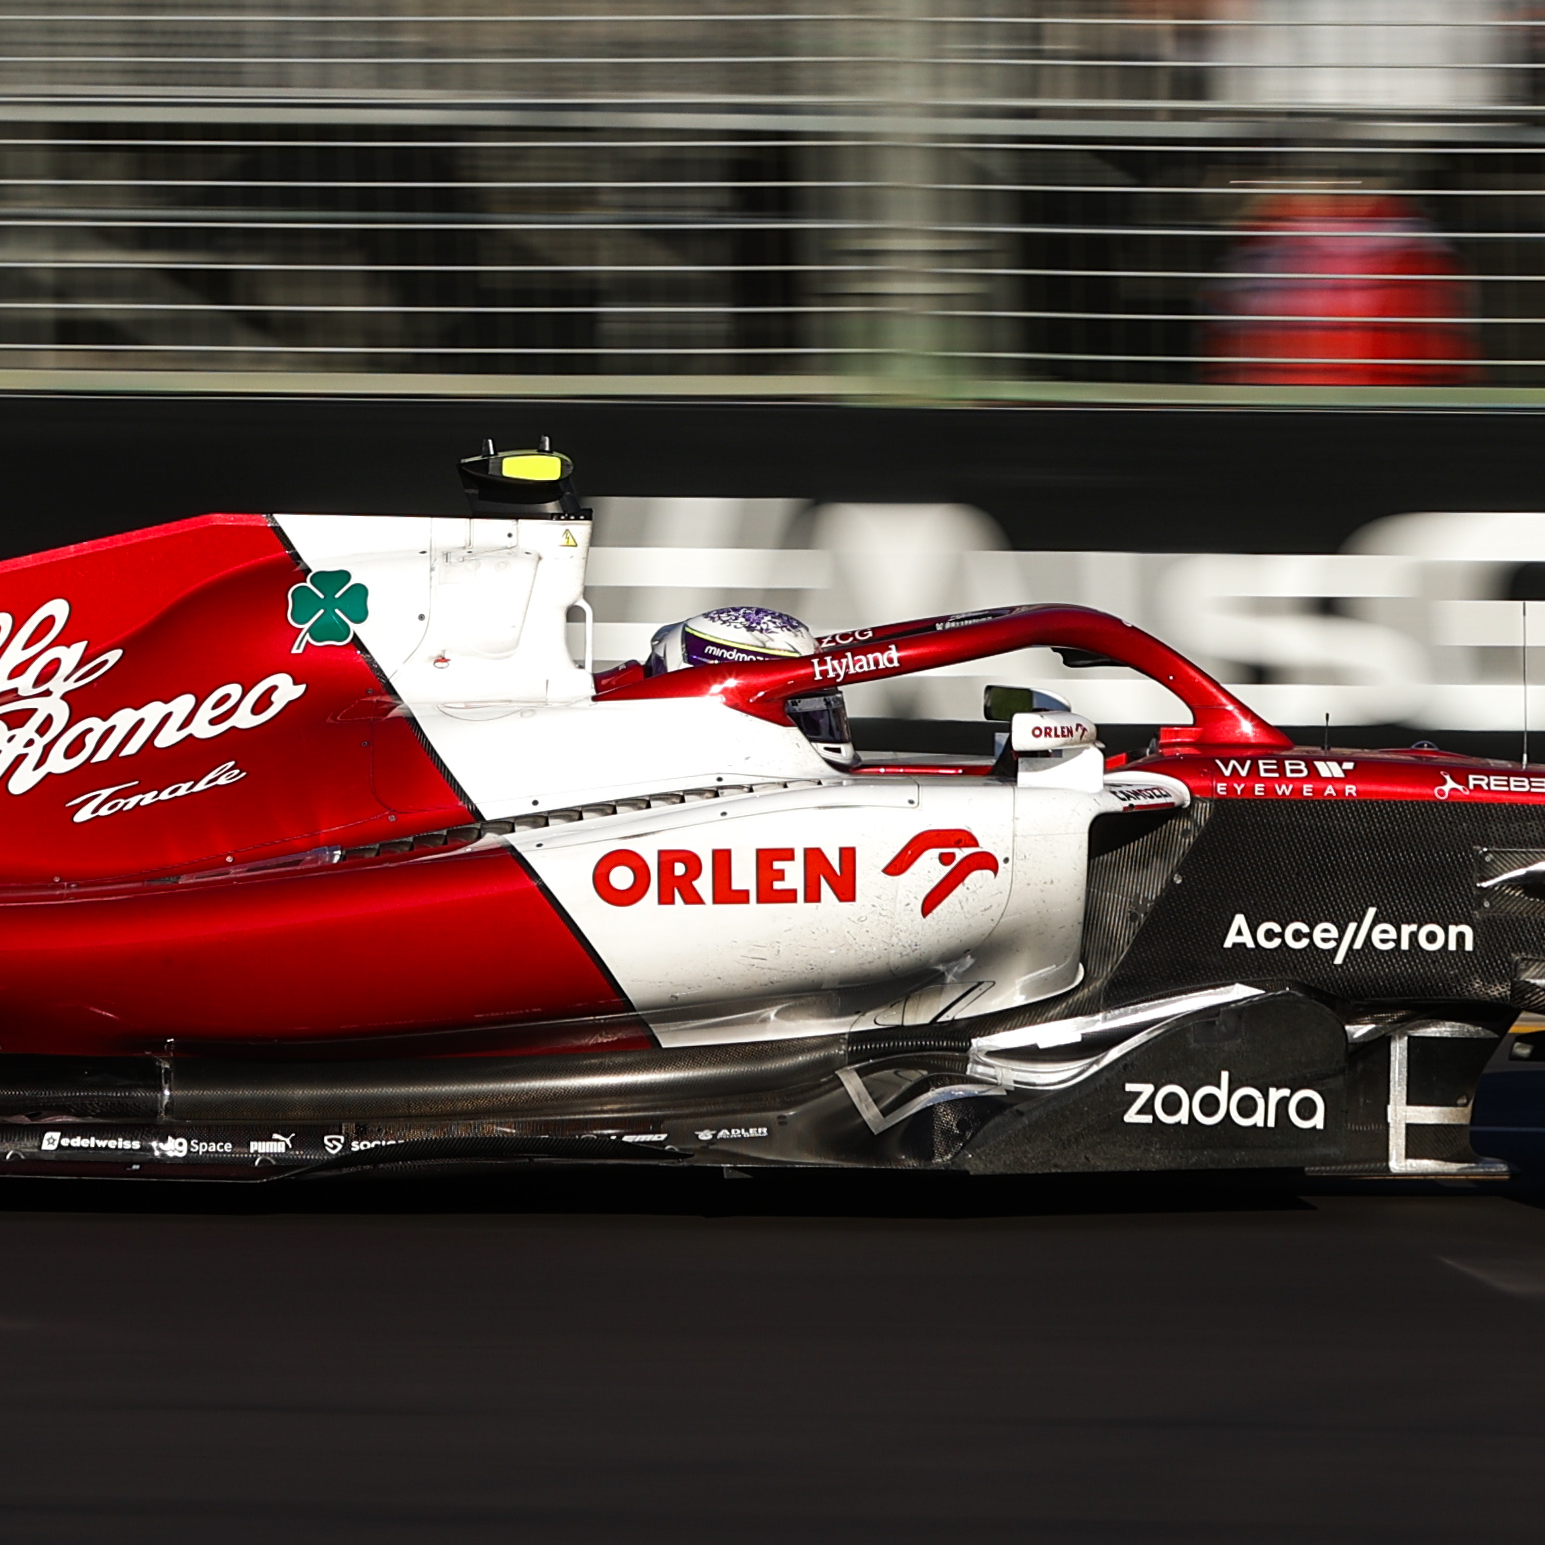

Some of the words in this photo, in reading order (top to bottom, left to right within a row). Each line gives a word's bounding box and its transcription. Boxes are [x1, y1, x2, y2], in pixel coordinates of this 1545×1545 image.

[813, 645, 900, 682] Hyland
[1032, 726, 1074, 739] ORLEN
[1215, 759, 1309, 778] WEB
[66, 761, 246, 822] Tonale
[1216, 783, 1357, 797] EYEWEAR
[593, 846, 856, 908] ORLEN
[1123, 1070, 1326, 1130] zadara
[718, 1127, 768, 1136] ADLER
[60, 1136, 141, 1151] edelweiss
[190, 1139, 233, 1155] Space
[249, 1141, 286, 1154] PUMA
